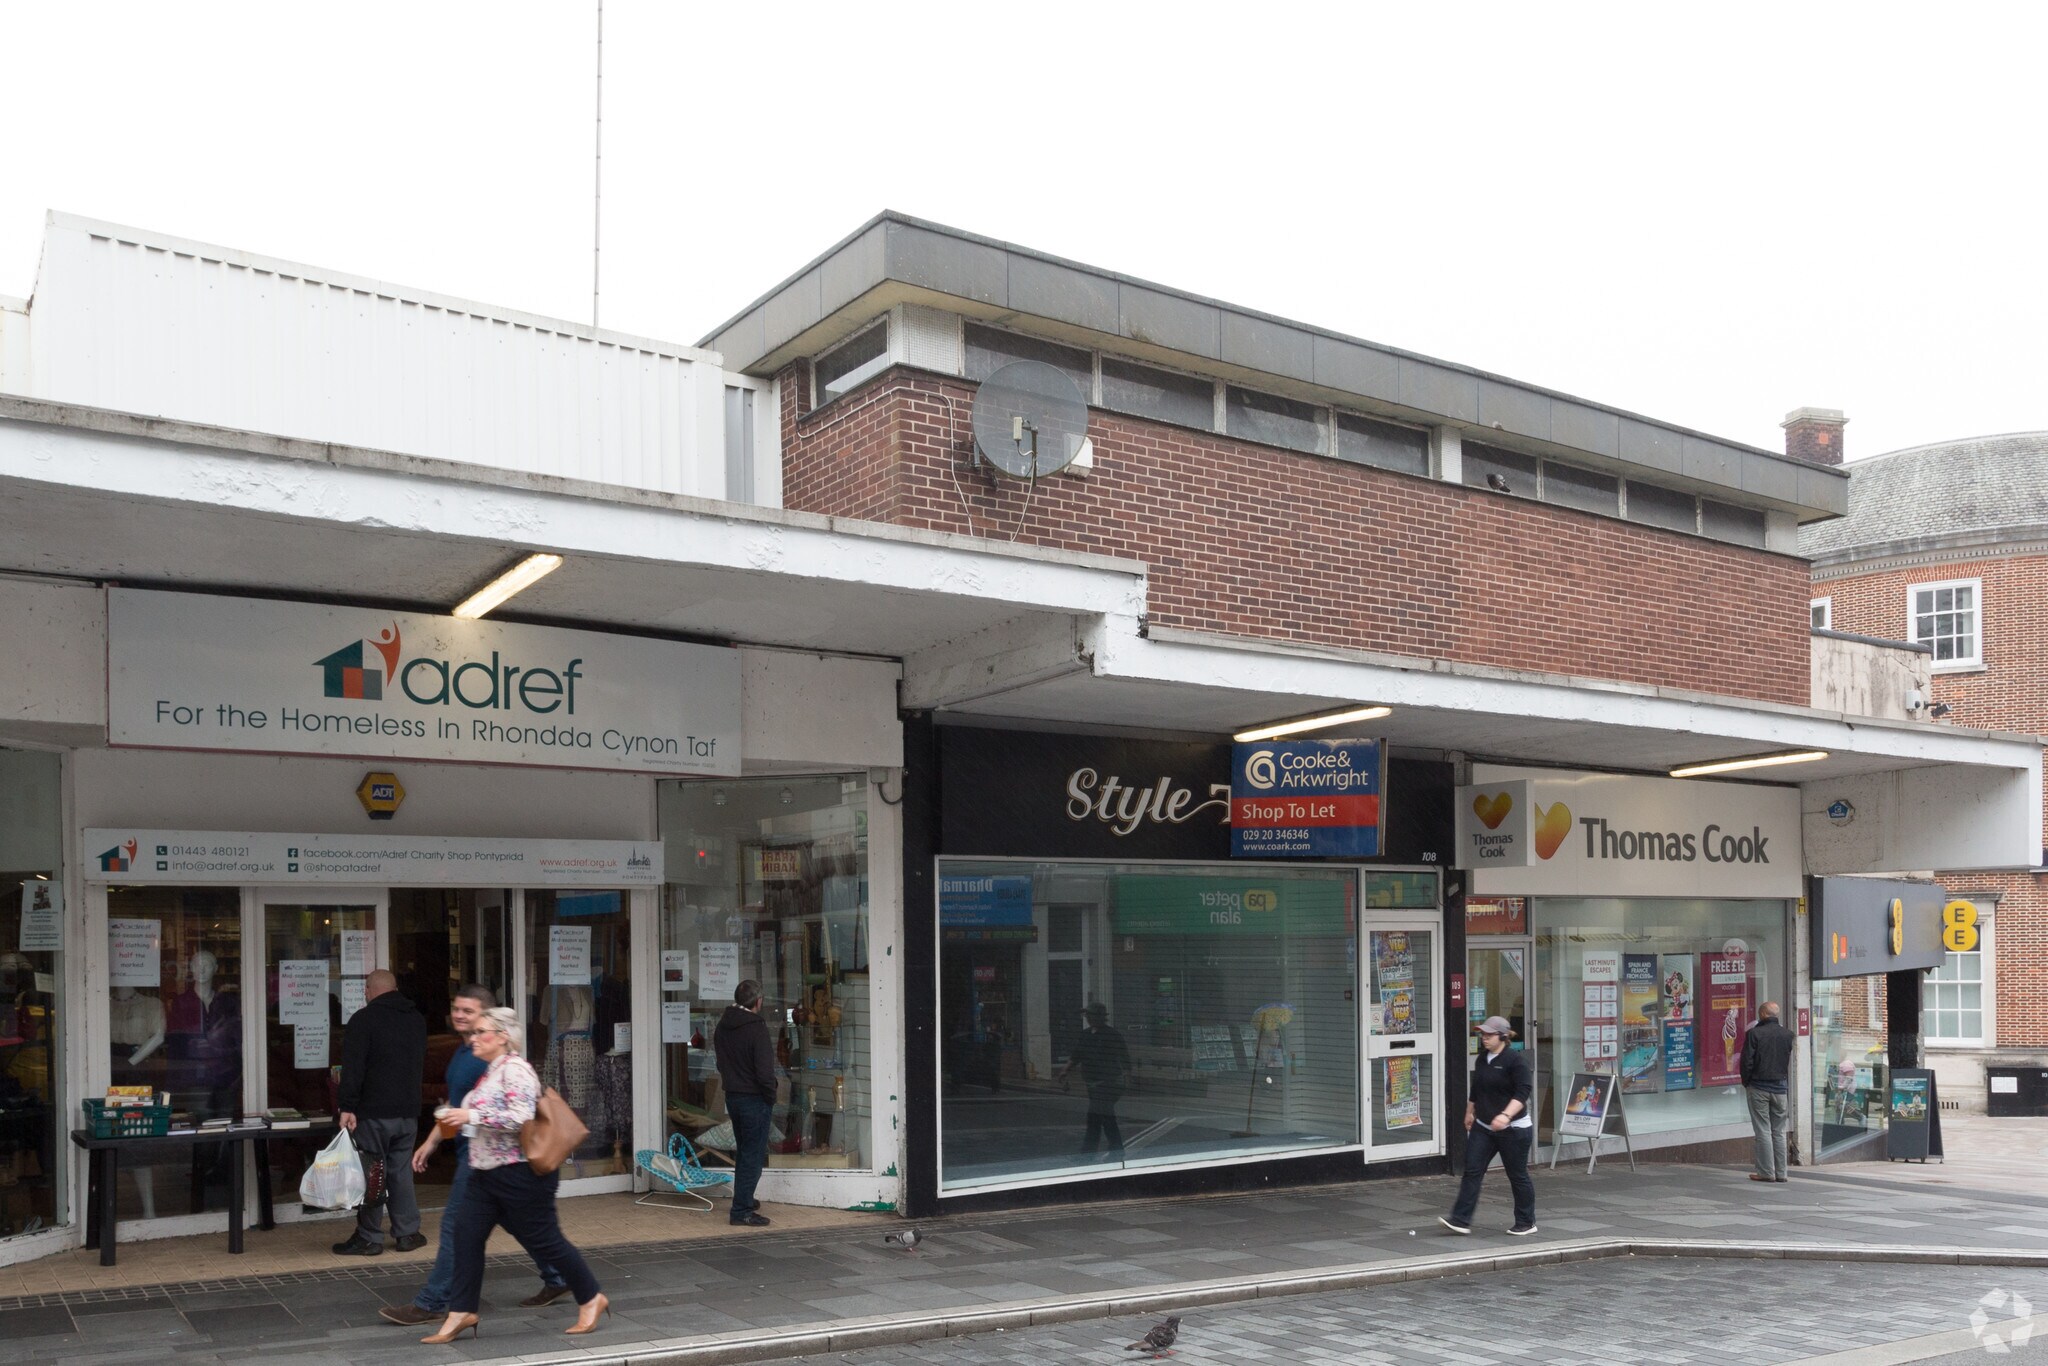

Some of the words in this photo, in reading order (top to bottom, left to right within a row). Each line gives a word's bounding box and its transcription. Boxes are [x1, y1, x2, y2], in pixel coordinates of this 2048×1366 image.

[401, 651, 582, 715] adref
[157, 700, 204, 725] For
[217, 704, 267, 729] the
[282, 708, 426, 738] Homeless
[438, 717, 460, 740] In
[472, 719, 592, 749] Rhondda
[602, 729, 678, 755] Cynon
[686, 736, 717, 758] Taf
[1280, 750, 1351, 770] Cooke&
[1281, 768, 1369, 791] Arkwright
[372, 788, 395, 798] ADT
[1066, 767, 1205, 837] Style
[1242, 804, 1284, 822] Shop
[1288, 803, 1306, 819] To
[1310, 802, 1336, 818] Let
[1243, 830, 1259, 841] 029
[1262, 830, 1273, 841] 20
[1275, 829, 1310, 841] 346346
[1473, 833, 1513, 846] Thomas
[1580, 817, 1697, 863] Thomas
[1703, 824, 1770, 864] Cook
[172, 846, 207, 857] 01443
[211, 847, 250, 857] 480121
[1243, 842, 1311, 853] www.coark.com
[1480, 846, 1506, 858] Cook
[303, 848, 408, 860] facebook.com/Adref
[411, 850, 445, 861] Charity
[447, 850, 473, 862] Shop
[475, 851, 524, 862] Pontypridd
[1422, 852, 1437, 862] 108
[172, 861, 275, 872] info@adref.org.uk
[304, 863, 381, 874] @shopatadref
[539, 858, 618, 869] www.adref.org.uk
[1711, 960, 1730, 973] FREE
[1731, 959, 1746, 972] £15
[1451, 981, 1461, 990] 109
